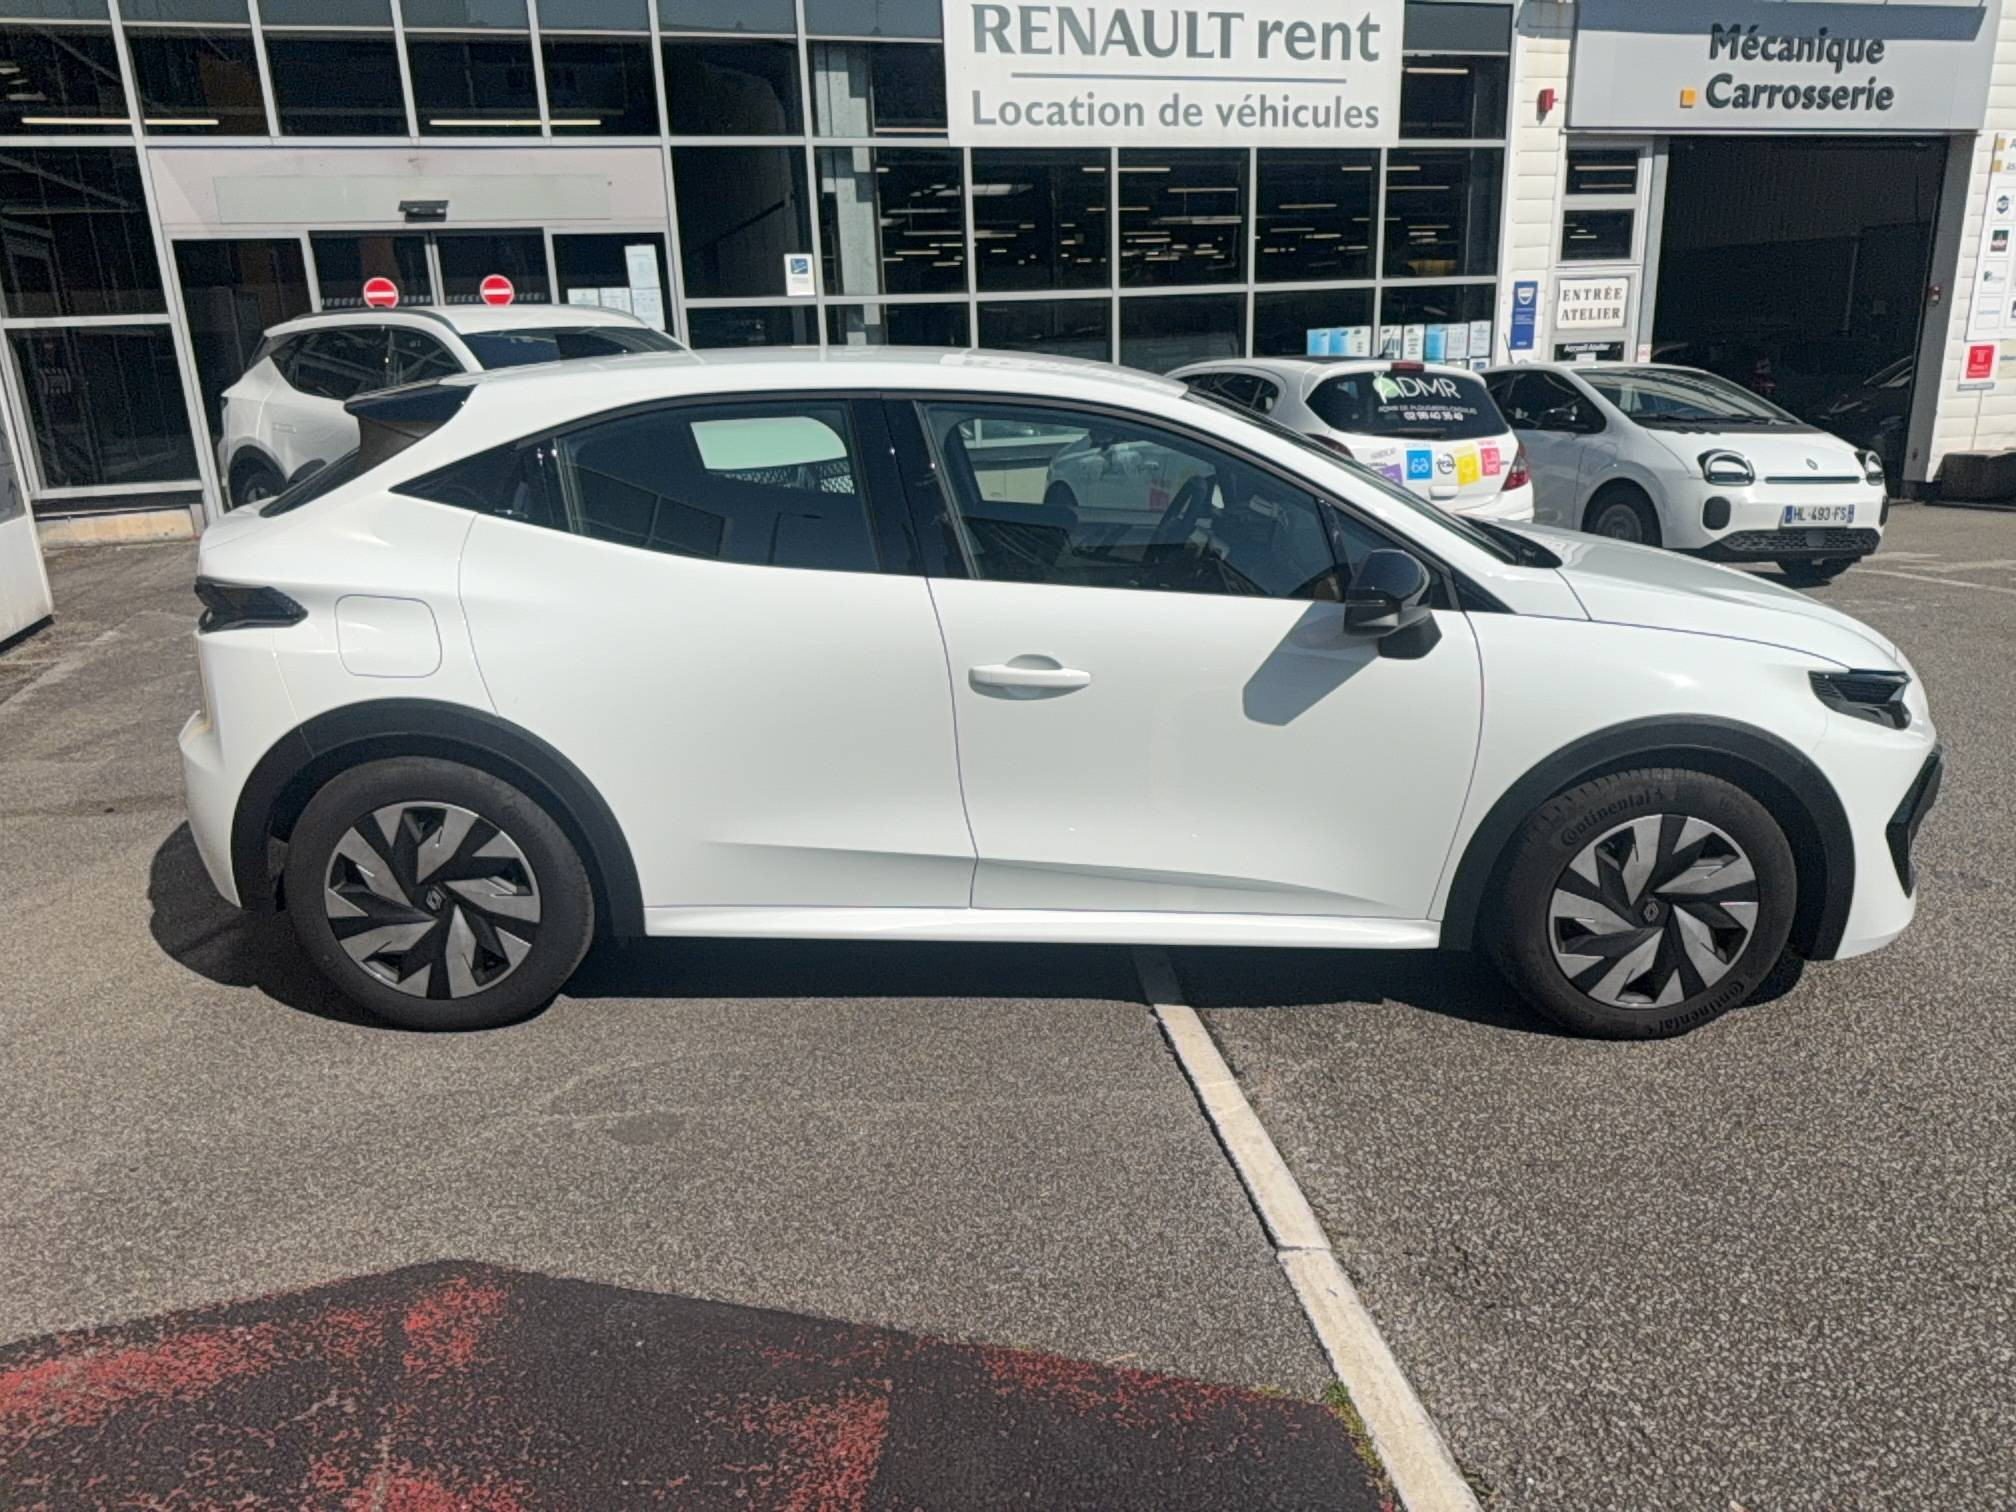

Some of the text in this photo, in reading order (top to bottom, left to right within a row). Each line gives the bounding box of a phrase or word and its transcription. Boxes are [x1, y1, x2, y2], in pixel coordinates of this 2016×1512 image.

[971, 3, 1382, 62] RENAULT rent
[1708, 23, 1886, 73] Mécanique
[971, 90, 1379, 129] Location de véhicules
[1705, 72, 1895, 111] Carrosserie
[1562, 285, 1623, 302] ENTRÉE
[1560, 307, 1621, 321] ATELIER
[1376, 376, 1462, 404] ADMR
[1560, 788, 1651, 846] Continental
[1659, 980, 1745, 1033] Continental
